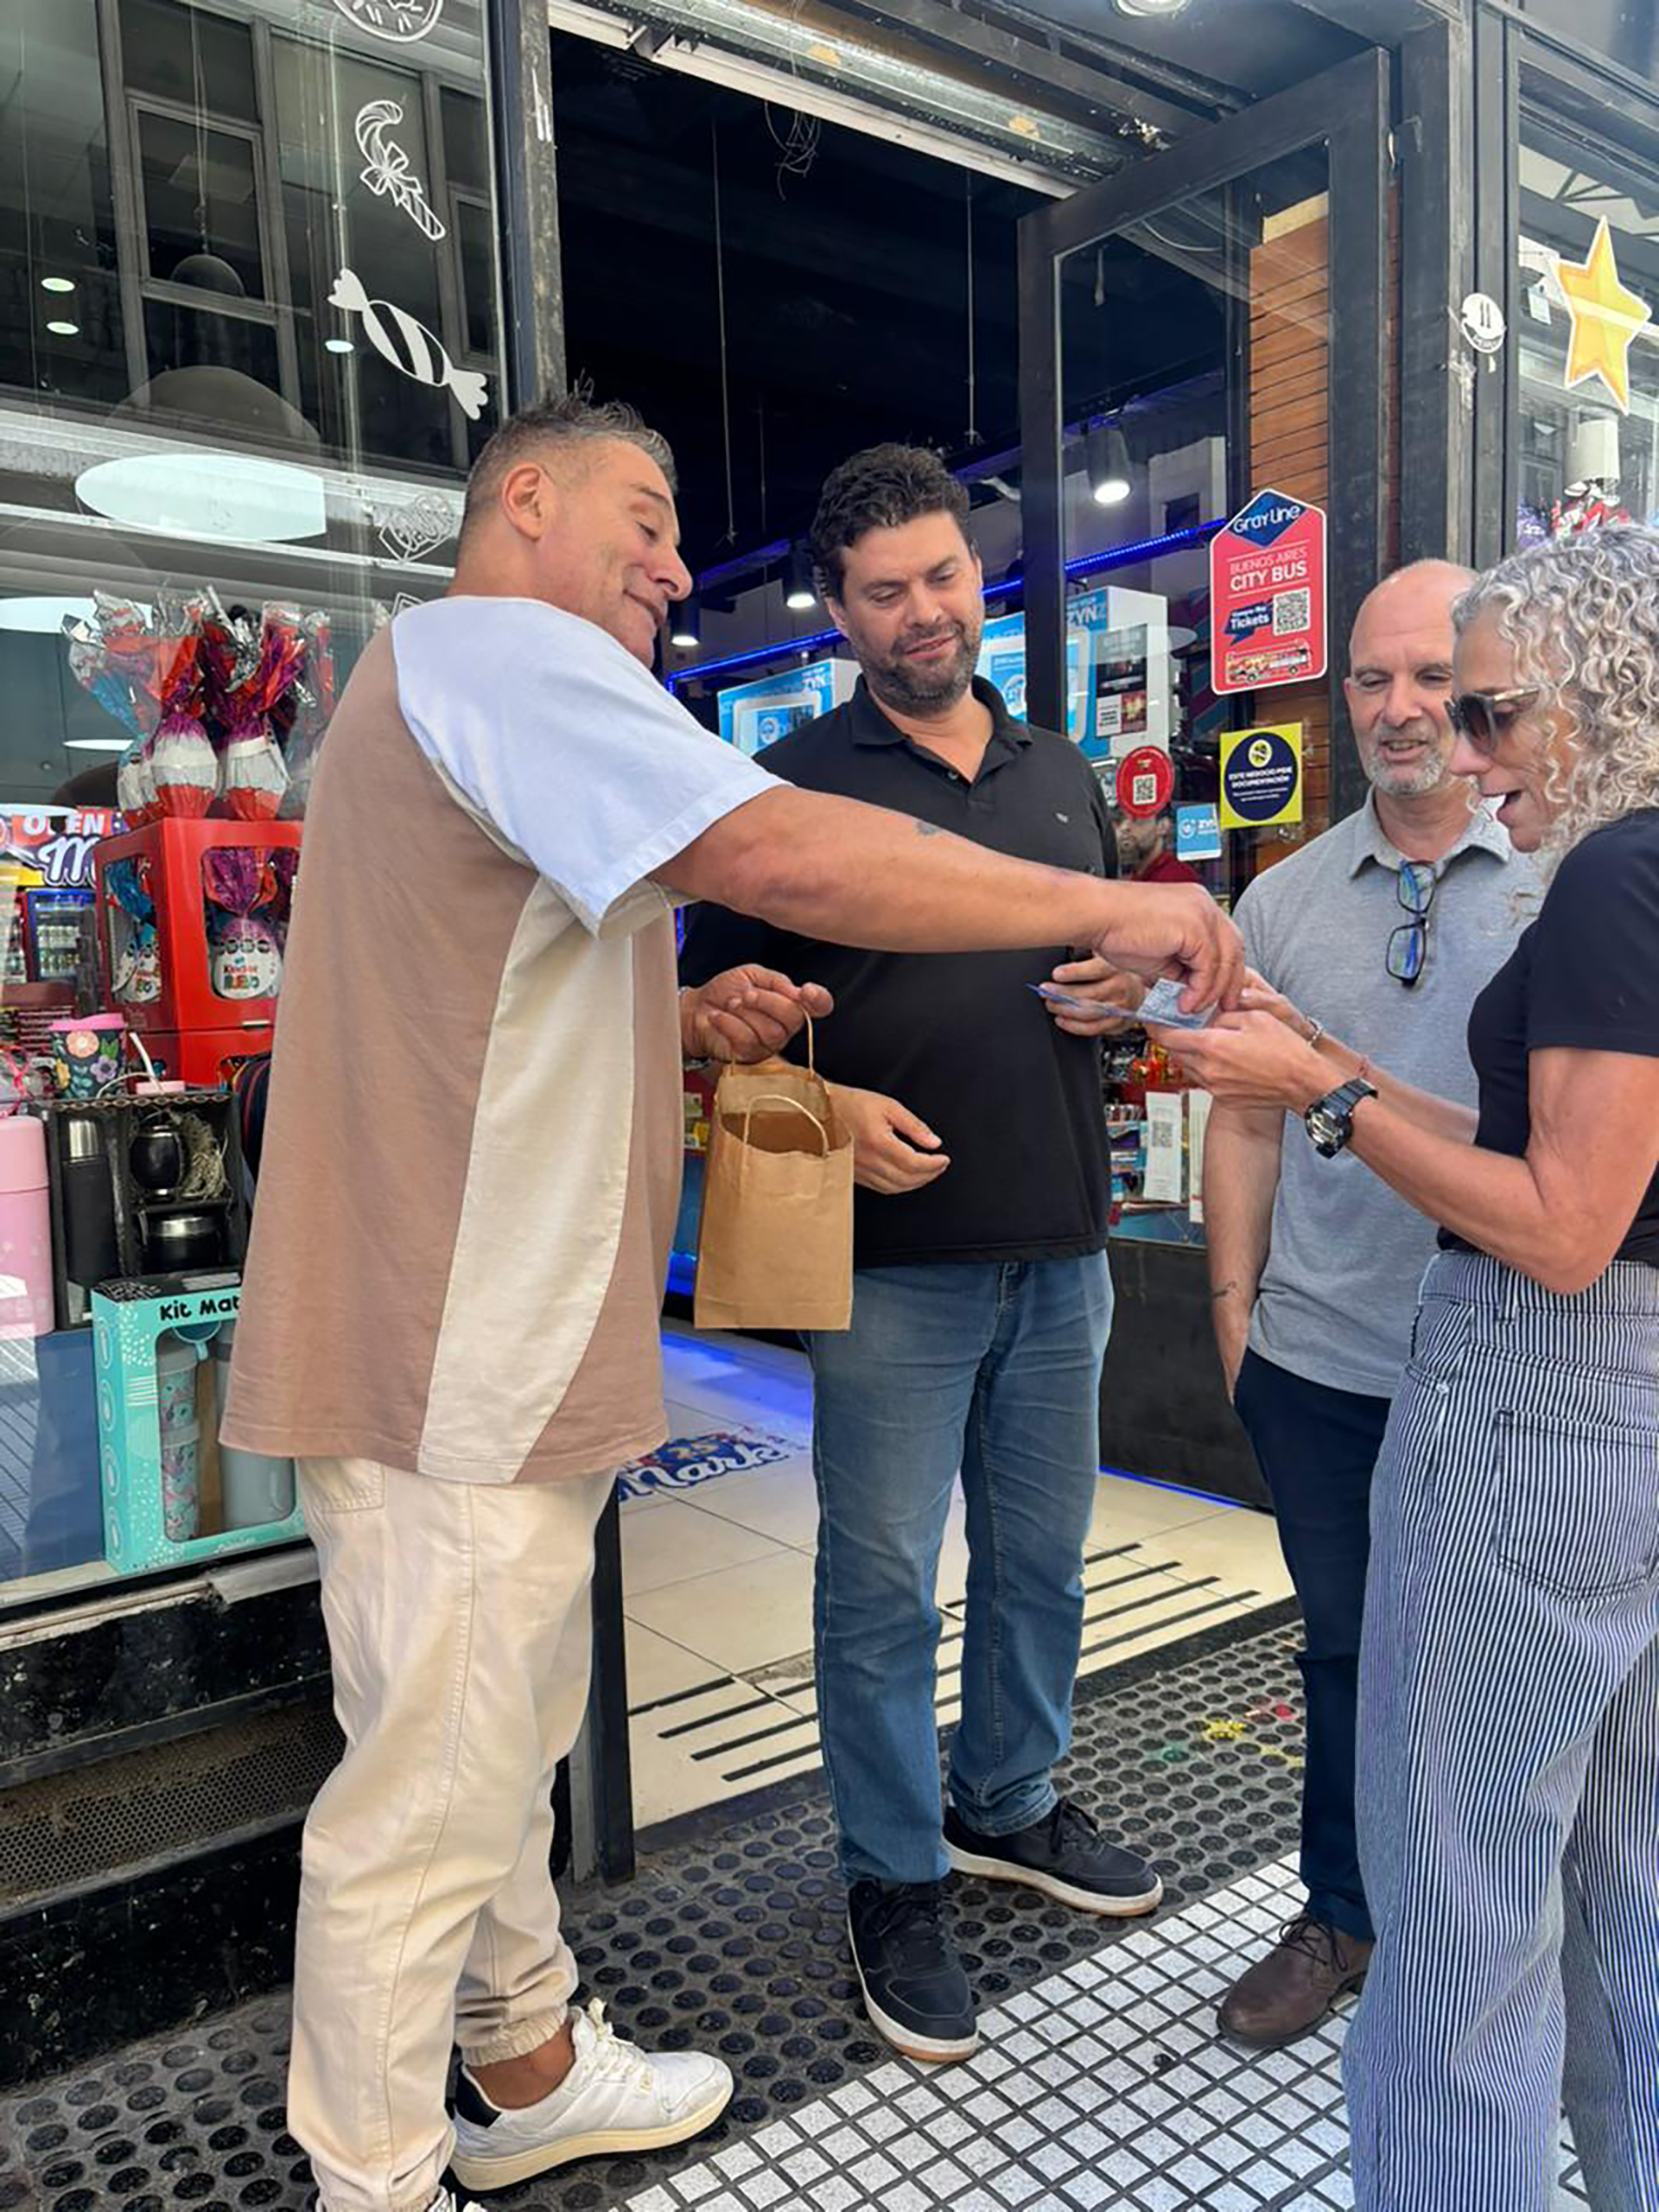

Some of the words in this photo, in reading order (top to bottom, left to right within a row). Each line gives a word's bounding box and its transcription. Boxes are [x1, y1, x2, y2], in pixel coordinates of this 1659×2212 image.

[1230, 555, 1274, 575] BUENOS
[1276, 546, 1307, 563] AIRES
[1230, 569, 1269, 591] CITY
[1272, 560, 1307, 582] BUS
[1230, 613, 1270, 630] Tickets
[160, 1300, 192, 1321] Kit
[199, 1295, 240, 1315] Mat
